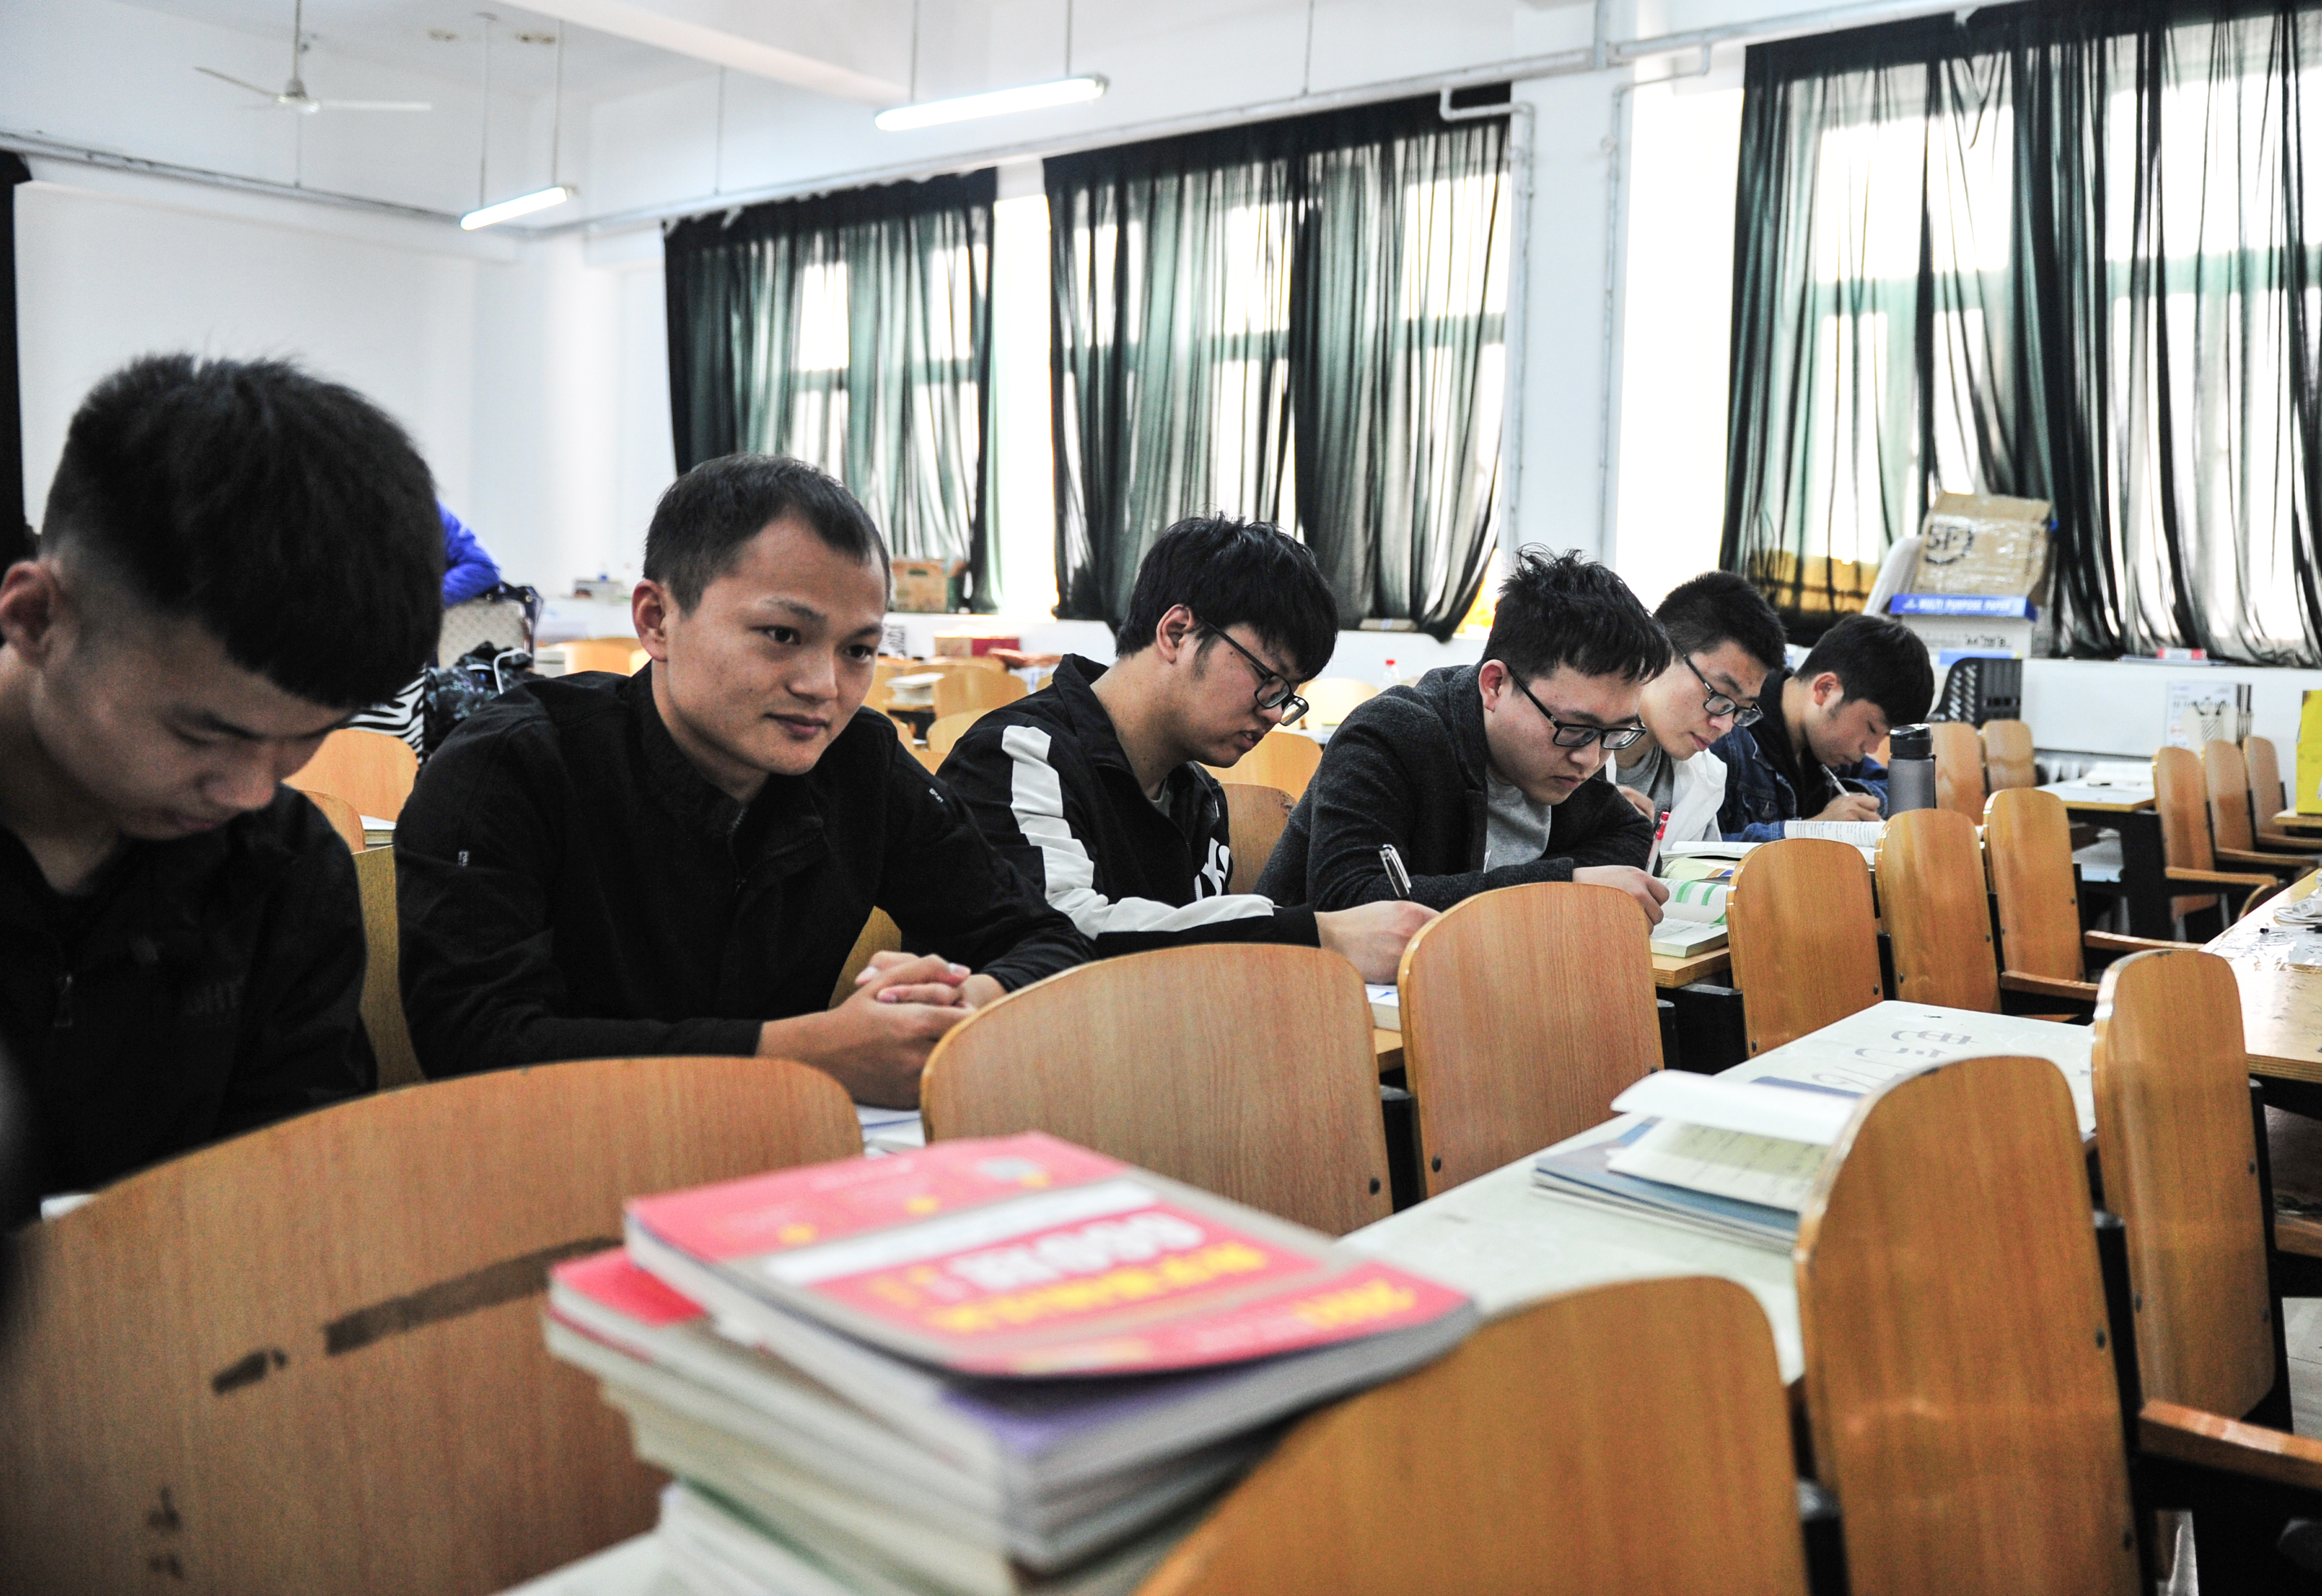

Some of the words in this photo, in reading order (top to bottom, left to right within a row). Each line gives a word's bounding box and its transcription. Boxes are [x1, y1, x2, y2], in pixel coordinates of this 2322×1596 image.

[1918, 598, 1944, 610] MULTI
[1945, 599, 1983, 611] PURPOSE
[1986, 600, 2011, 611] PAPER
